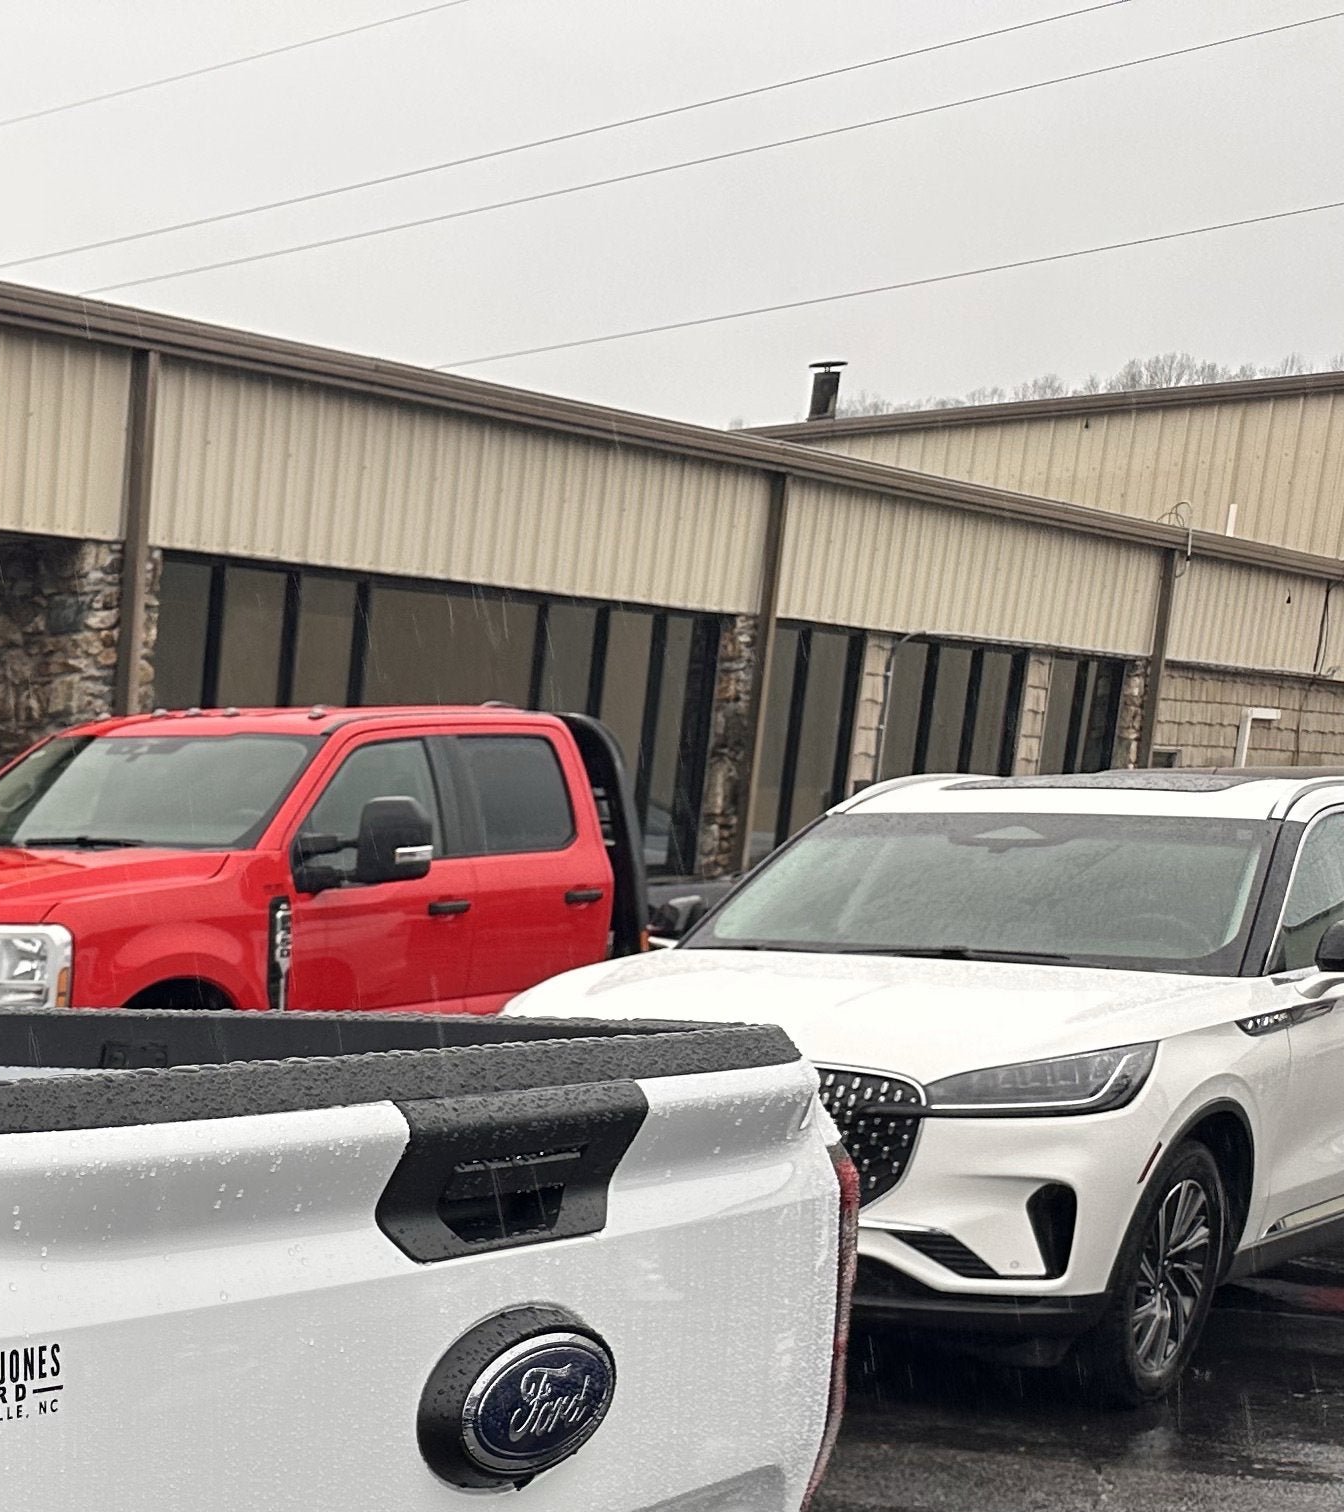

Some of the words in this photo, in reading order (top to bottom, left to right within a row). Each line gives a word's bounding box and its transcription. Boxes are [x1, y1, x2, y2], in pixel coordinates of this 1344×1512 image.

[0, 1343, 61, 1386] JONES
[39, 1398, 59, 1416] NC
[509, 1362, 592, 1443] Ford
